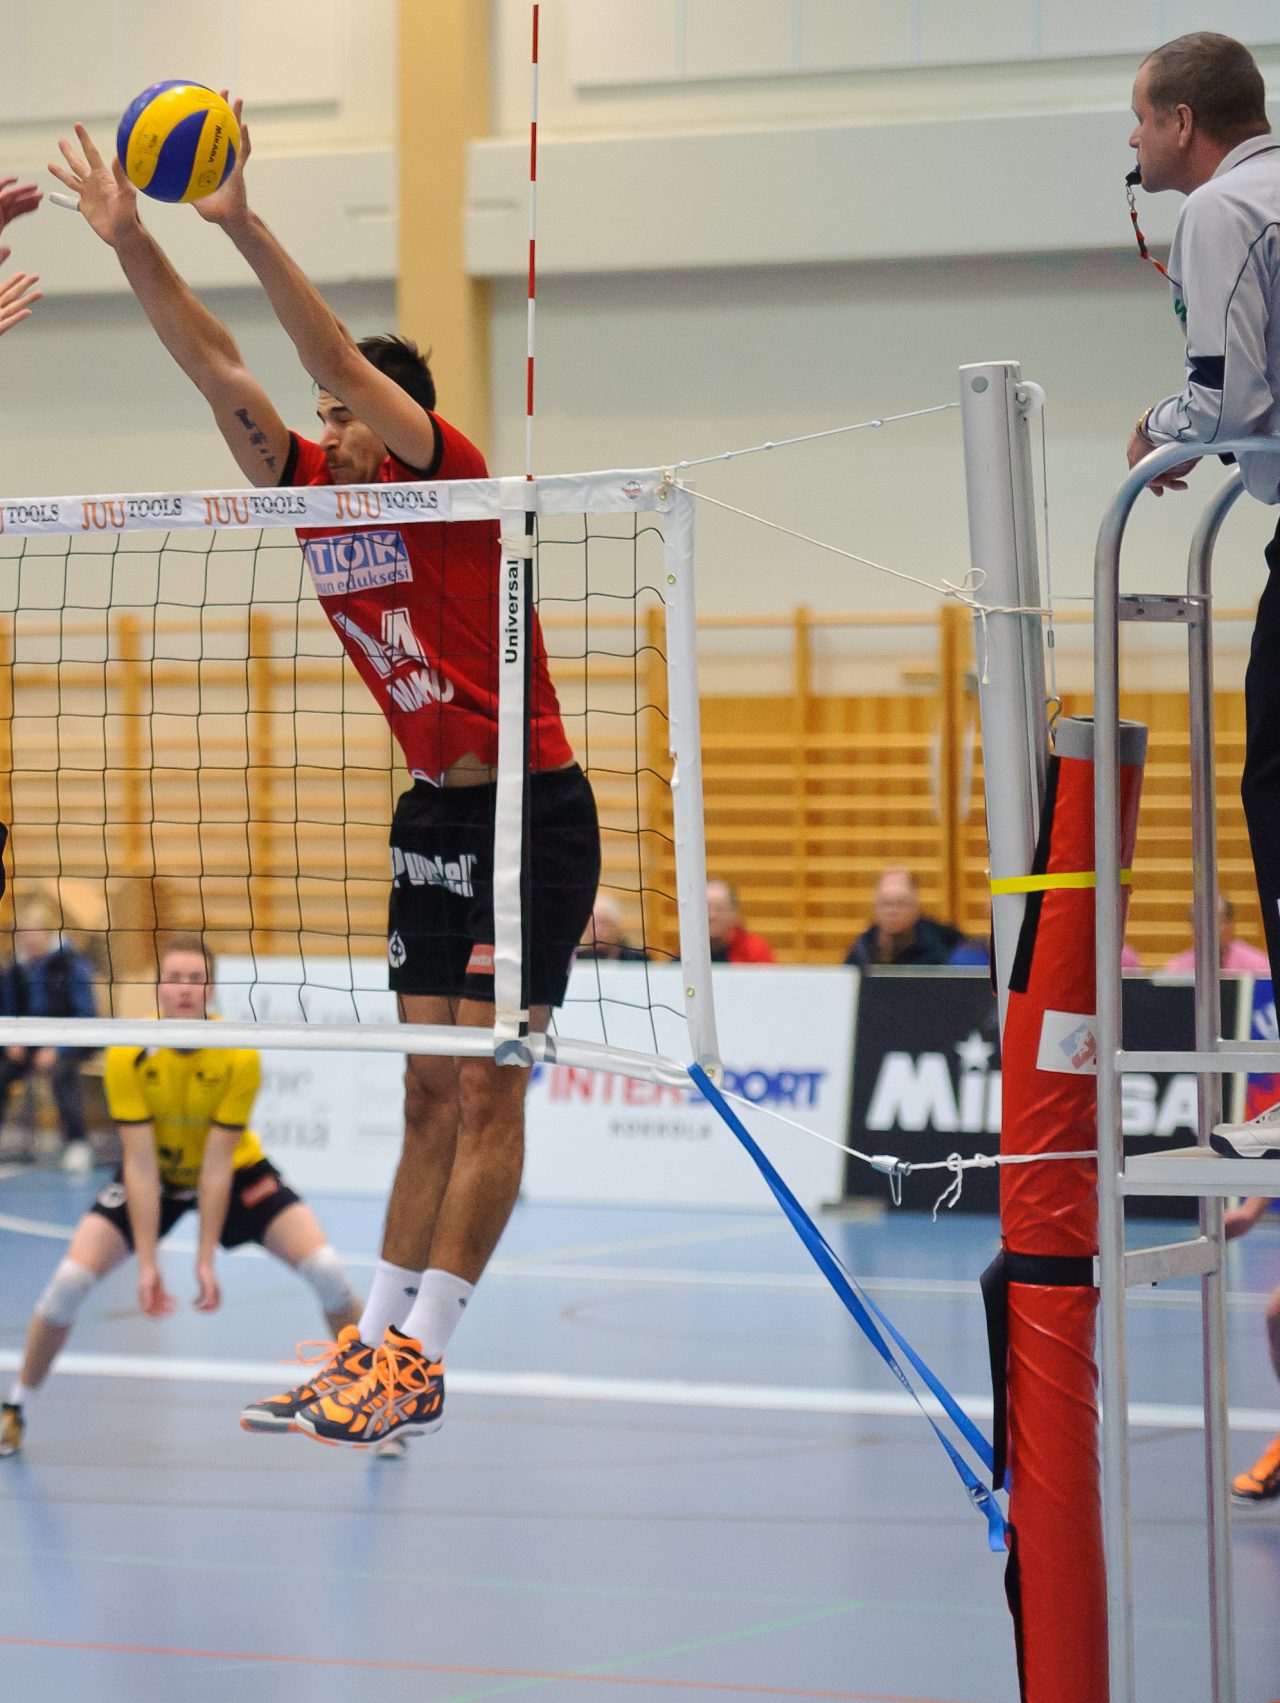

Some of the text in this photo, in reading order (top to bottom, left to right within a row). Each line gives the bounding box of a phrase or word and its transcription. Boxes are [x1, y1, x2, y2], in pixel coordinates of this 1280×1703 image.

[7, 504, 59, 524] TOOLS
[81, 498, 182, 530] JUU TOOLS
[204, 495, 307, 525] JUU TOOLS
[335, 490, 438, 519] JUU TOOLS
[307, 531, 407, 574] TOK
[337, 565, 410, 590] eduksesi
[503, 559, 519, 664] Universal
[549, 1064, 827, 1107] INTERPORT
[865, 1028, 1198, 1137] MiSA
